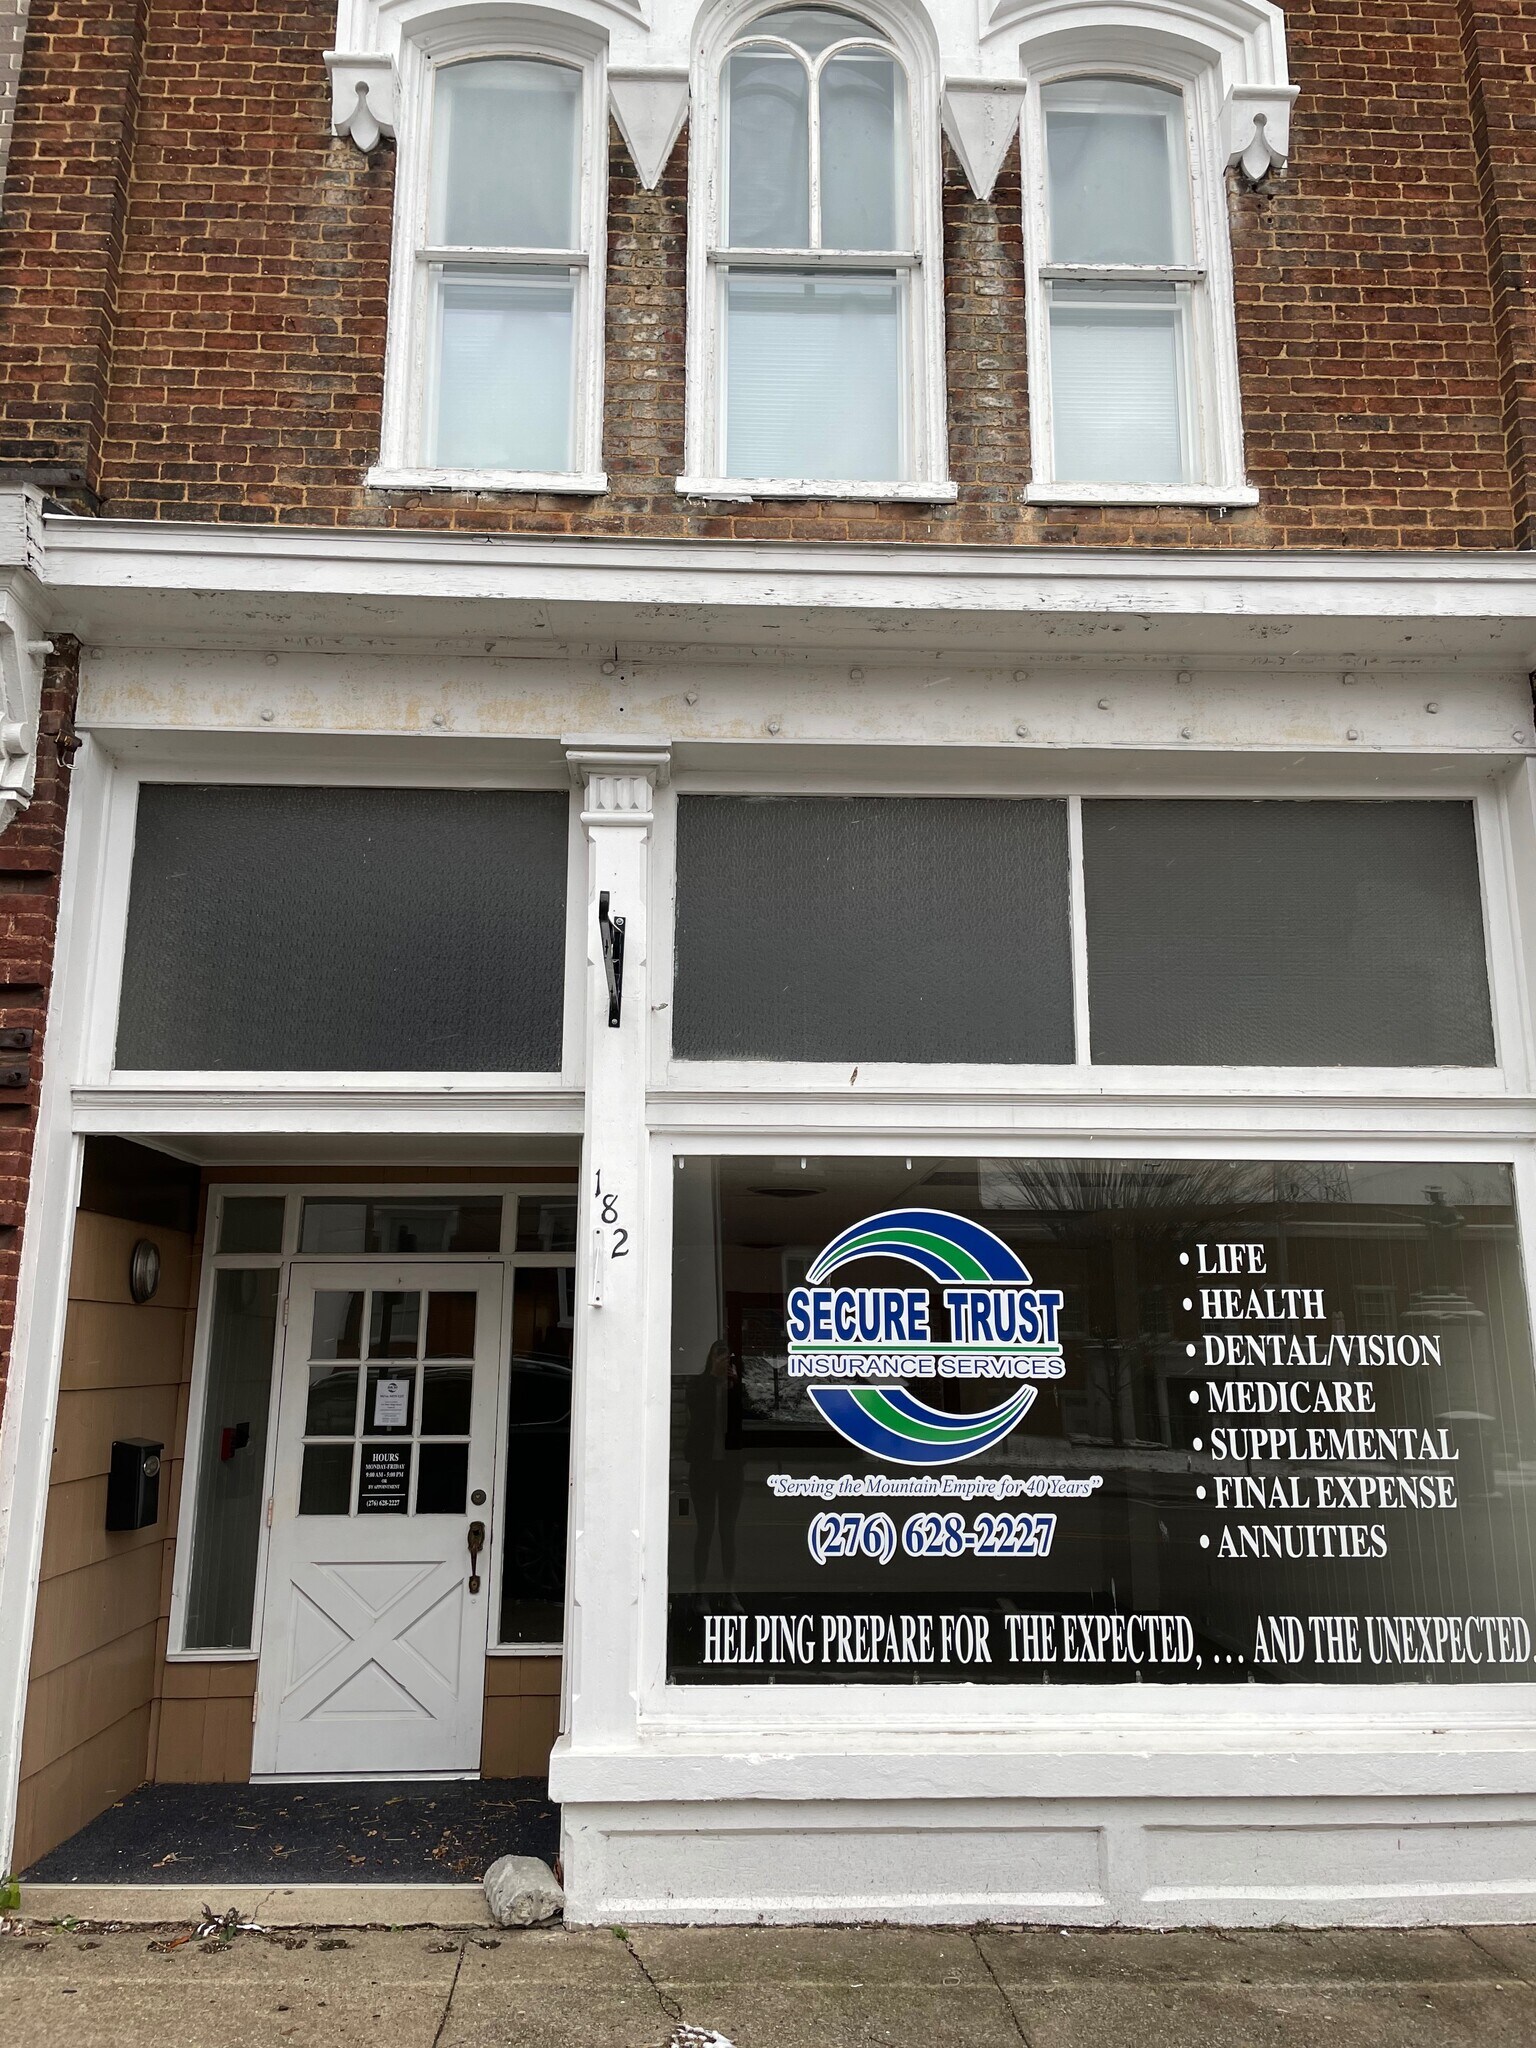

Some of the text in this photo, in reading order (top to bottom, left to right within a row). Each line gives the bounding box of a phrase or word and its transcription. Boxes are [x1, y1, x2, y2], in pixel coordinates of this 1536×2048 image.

[1196, 1244, 1267, 1274] LIFE
[789, 1289, 1062, 1343] SECURE TRUST
[1199, 1289, 1327, 1320] HEALTH
[790, 1357, 1064, 1377] INSURANCE SERVICES
[1203, 1334, 1442, 1367] DENTAL/VISION
[1206, 1381, 1376, 1414] MEDICARE
[372, 1453, 399, 1462] HOURS
[1211, 1428, 1459, 1461] SUPPLEMENTAL
[839, 1477, 862, 1494] the
[866, 1477, 938, 1495] Mountain
[943, 1477, 997, 1499] Empire
[999, 1477, 1023, 1499] for
[1026, 1477, 1046, 1494] 40
[1214, 1476, 1458, 1510] FINAL EXPENSE
[810, 1514, 1055, 1563] (276) 628-2227
[1217, 1524, 1388, 1558] ANNUITIES
[703, 1614, 815, 1664] HELPING
[821, 1614, 934, 1664] PREPARE
[939, 1614, 993, 1664] FOR
[1004, 1614, 1056, 1663] THE
[1253, 1615, 1304, 1664] AND
[1308, 1616, 1362, 1664] THE
